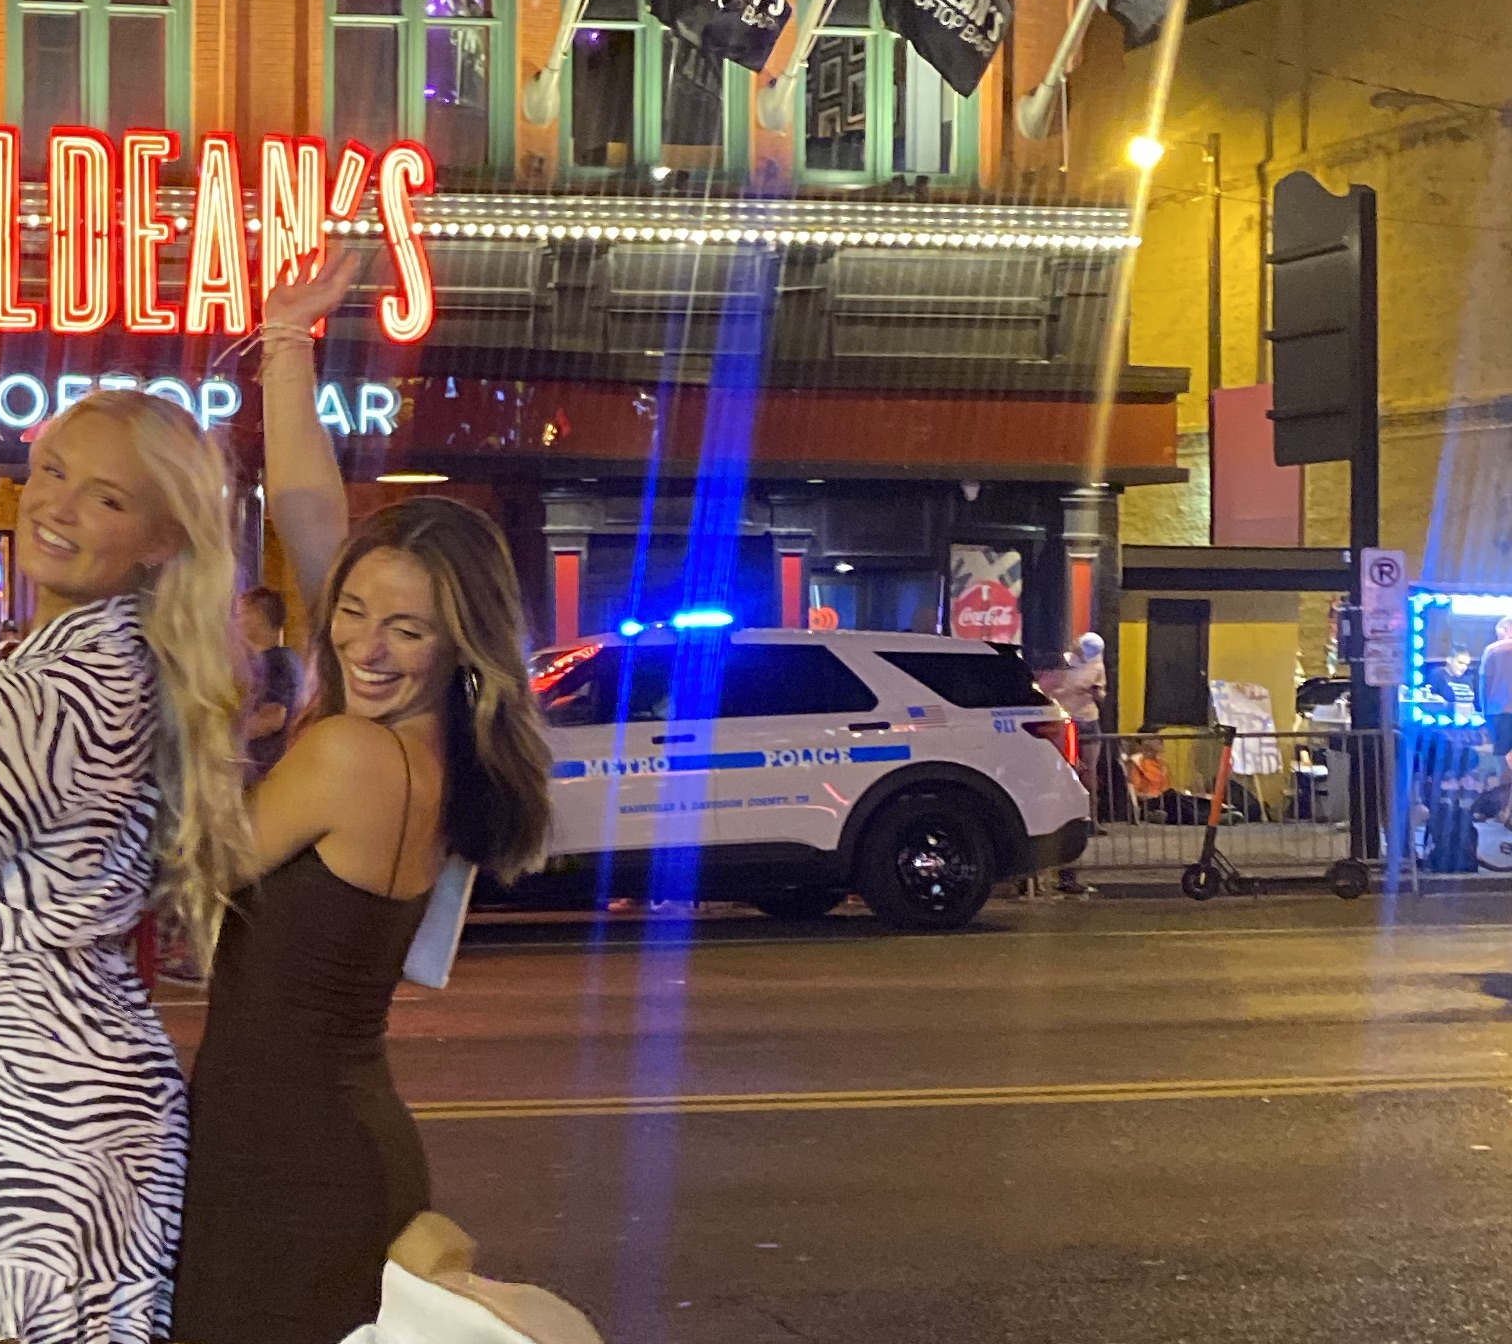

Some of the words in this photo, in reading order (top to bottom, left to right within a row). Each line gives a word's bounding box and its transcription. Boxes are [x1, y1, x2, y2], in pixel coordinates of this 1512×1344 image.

[316, 382, 401, 436] AR
[585, 757, 670, 778] METRO
[765, 746, 852, 768] POLICE
